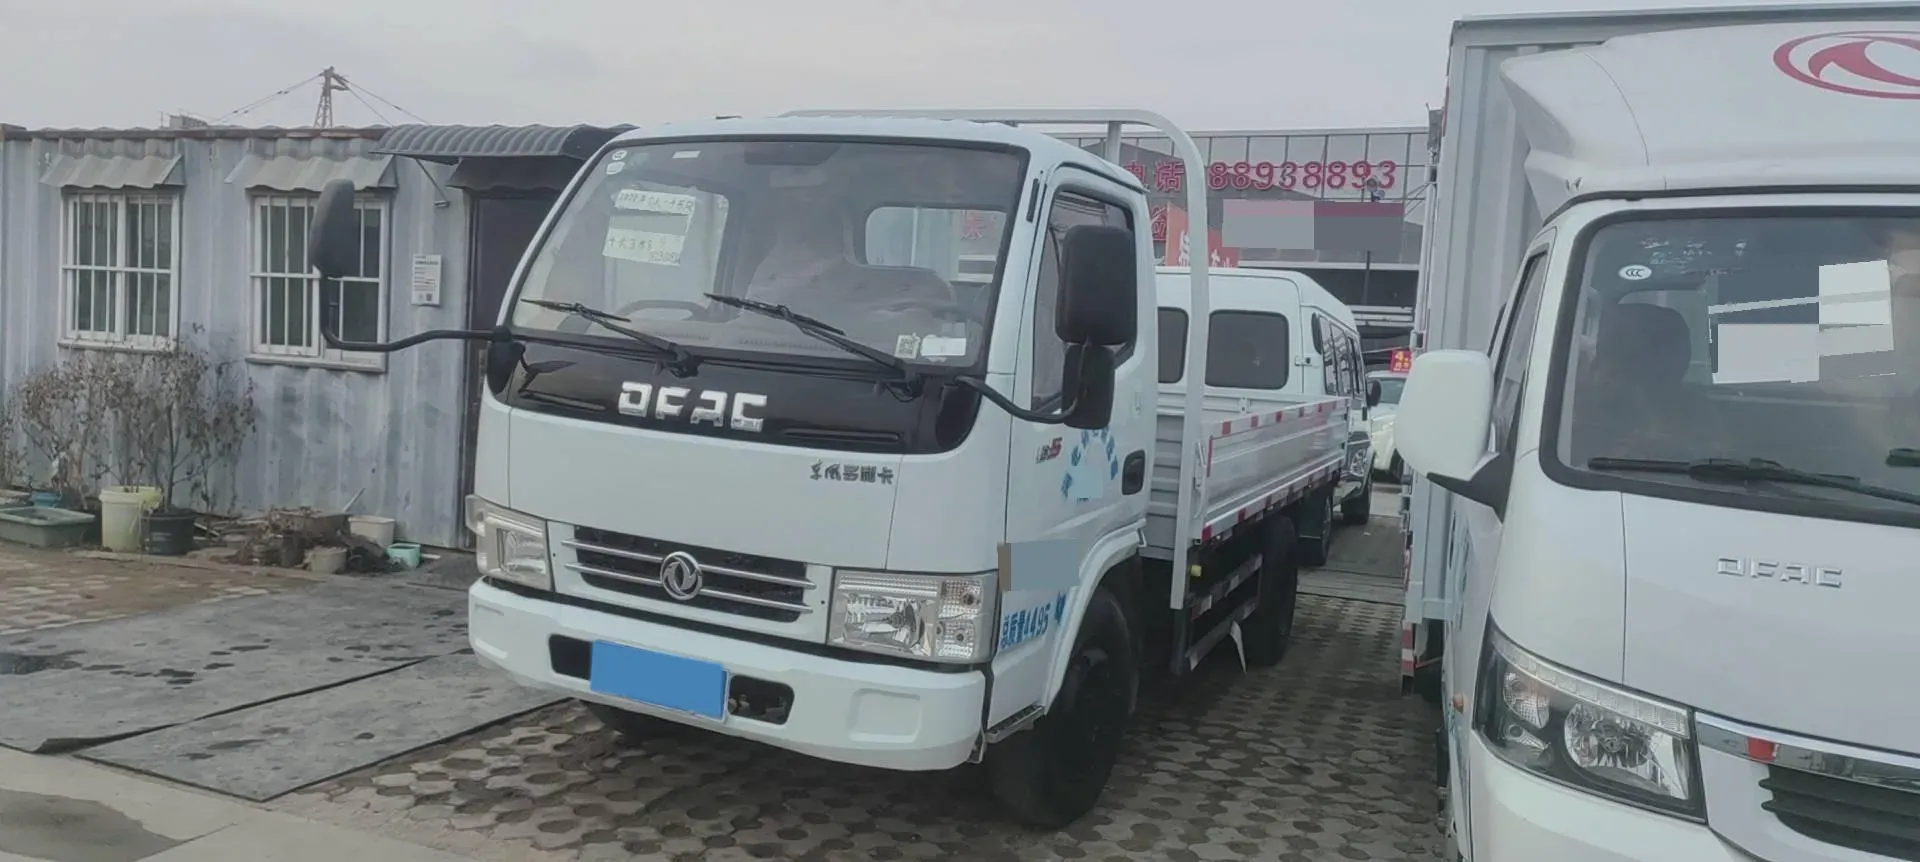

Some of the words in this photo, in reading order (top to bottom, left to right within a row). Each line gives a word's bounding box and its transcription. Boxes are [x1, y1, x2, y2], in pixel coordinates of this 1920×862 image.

[1208, 160, 1397, 191] 88938893
[618, 381, 767, 432] DFAC
[1717, 556, 1842, 589] DFAC
